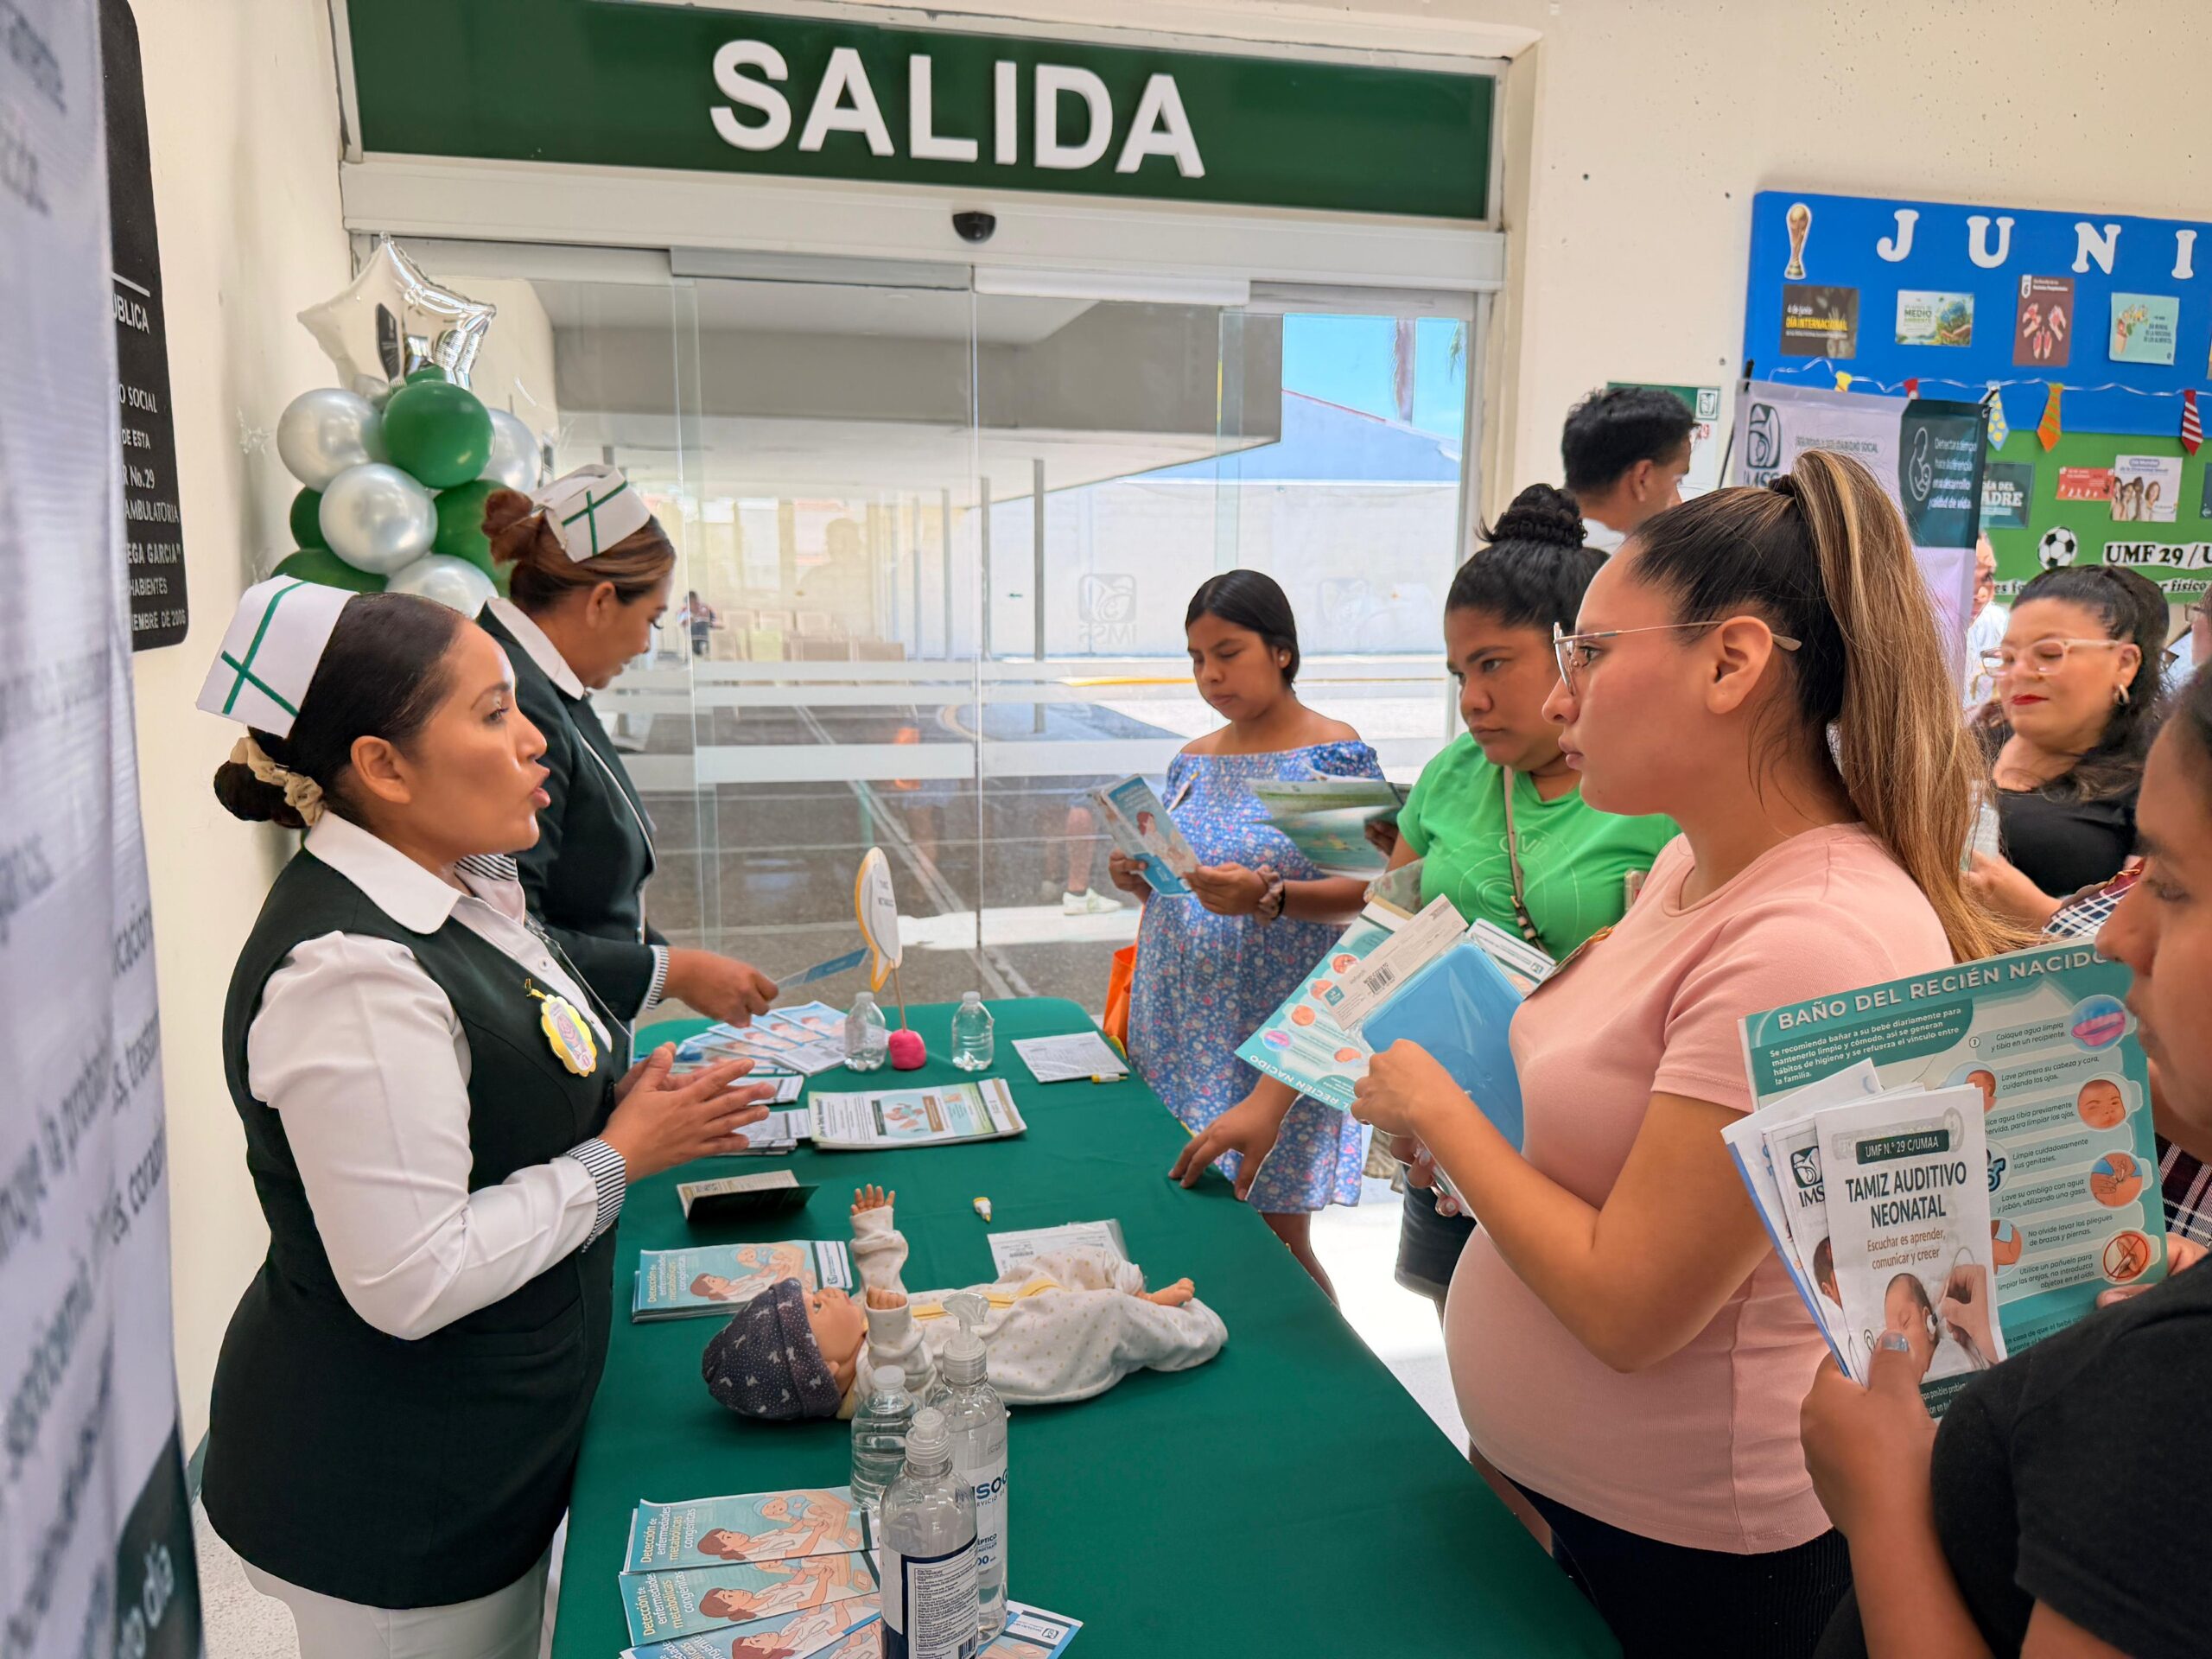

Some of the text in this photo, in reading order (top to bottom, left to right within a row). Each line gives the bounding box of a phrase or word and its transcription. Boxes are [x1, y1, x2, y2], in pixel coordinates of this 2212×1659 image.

[709, 39, 1206, 178] SALIDA
[112, 293, 149, 334] UBLICA
[128, 385, 157, 413] SOCIAL
[121, 429, 151, 449] DE ESTA
[1981, 491, 2023, 506] ADRE
[125, 498, 180, 523] AMBULATORIA
[2106, 544, 2198, 567] UMF 29 /
[130, 611, 158, 632] IEMBRE
[162, 610, 170, 626] DE
[1778, 1001, 1847, 1030] BAÑO
[1854, 988, 1902, 1013] DEL
[1909, 967, 1999, 1000] RECIÉN
[1770, 1048, 1780, 1058] Se
[1782, 1038, 1827, 1055] recomienda
[1828, 1031, 1851, 1046] bañar
[1872, 1021, 1891, 1034] bebé
[1892, 1012, 1941, 1028] diariamente
[1943, 1008, 1961, 1020] para
[1991, 1045, 1995, 1053] y
[1996, 1039, 2011, 1052] tibia
[2031, 1031, 2065, 1046] recipiente.
[1996, 1021, 2063, 1042] Coloque agua limpia
[1772, 1050, 1816, 1067] mantenerlo
[1818, 1042, 1842, 1058] limpio
[1844, 1042, 1848, 1051] y
[1851, 1033, 1885, 1047] cómodo,
[1886, 1030, 1897, 1039] así
[1910, 1021, 1943, 1035] generan
[1774, 1062, 1802, 1076] hábitos
[1804, 1058, 1814, 1068] de
[1815, 1052, 1844, 1065] higiene
[1864, 1041, 1896, 1054] refuerza
[1897, 1037, 1905, 1046] el
[1906, 1031, 1936, 1044] vínculo
[1938, 1027, 1959, 1038] entre
[1249, 1055, 1295, 1083] NACIDO
[1776, 1071, 1812, 1086] la familia.
[2001, 1073, 2017, 1082] Lave
[2018, 1067, 2044, 1079] primero
[2053, 1060, 2076, 1071] cabeza
[2082, 1056, 2100, 1065] cara,
[2002, 1078, 2033, 1090] cuidando
[2033, 1076, 2044, 1084] los
[1999, 1102, 2072, 1124] agua tibia previamente
[2011, 1122, 2026, 1131] para
[2026, 1116, 2050, 1128] limpiar
[1865, 1135, 1939, 1158] UMF 29 C/UMAA
[2012, 1138, 2088, 1160] Limpie cuidadosamente
[1846, 1161, 1967, 1203] TAMIZ AUDITIVO
[2001, 1193, 2017, 1202] Lave
[2026, 1185, 2053, 1198] ombligo
[2067, 1179, 2084, 1189] agua
[1870, 1194, 1946, 1229] NEONATAL
[2023, 1194, 2055, 1207] utilizando
[2038, 1226, 2058, 1236] olvide
[2058, 1223, 2075, 1233] lavar
[2086, 1214, 2113, 1228] pliegues
[1867, 1228, 1946, 1252] Escuchar es aprender,
[2029, 1238, 2037, 1247] de
[2038, 1235, 2060, 1245] brazos
[1872, 1249, 1940, 1270] comunicar y crecer
[2019, 1267, 2039, 1275] Utilice
[2077, 1254, 2092, 1263] para
[1998, 1280, 2018, 1292] limpiar
[2060, 1262, 2094, 1276] introduzca
[2041, 1279, 2063, 1289] objetos
[2012, 1332, 2027, 1342] caso
[2037, 1326, 2049, 1337] que
[976, 1495, 998, 1508] RVICIO
[640, 1516, 658, 1563] Detección de
[657, 1506, 671, 1555] enfermedades
[670, 1516, 683, 1561] metabólicas
[683, 1508, 698, 1549] congénitas
[977, 1533, 997, 1546] ÉPTICO
[675, 1571, 695, 1613] congénitas
[636, 1586, 656, 1637] Detección de
[663, 1580, 683, 1629] metabólicas
